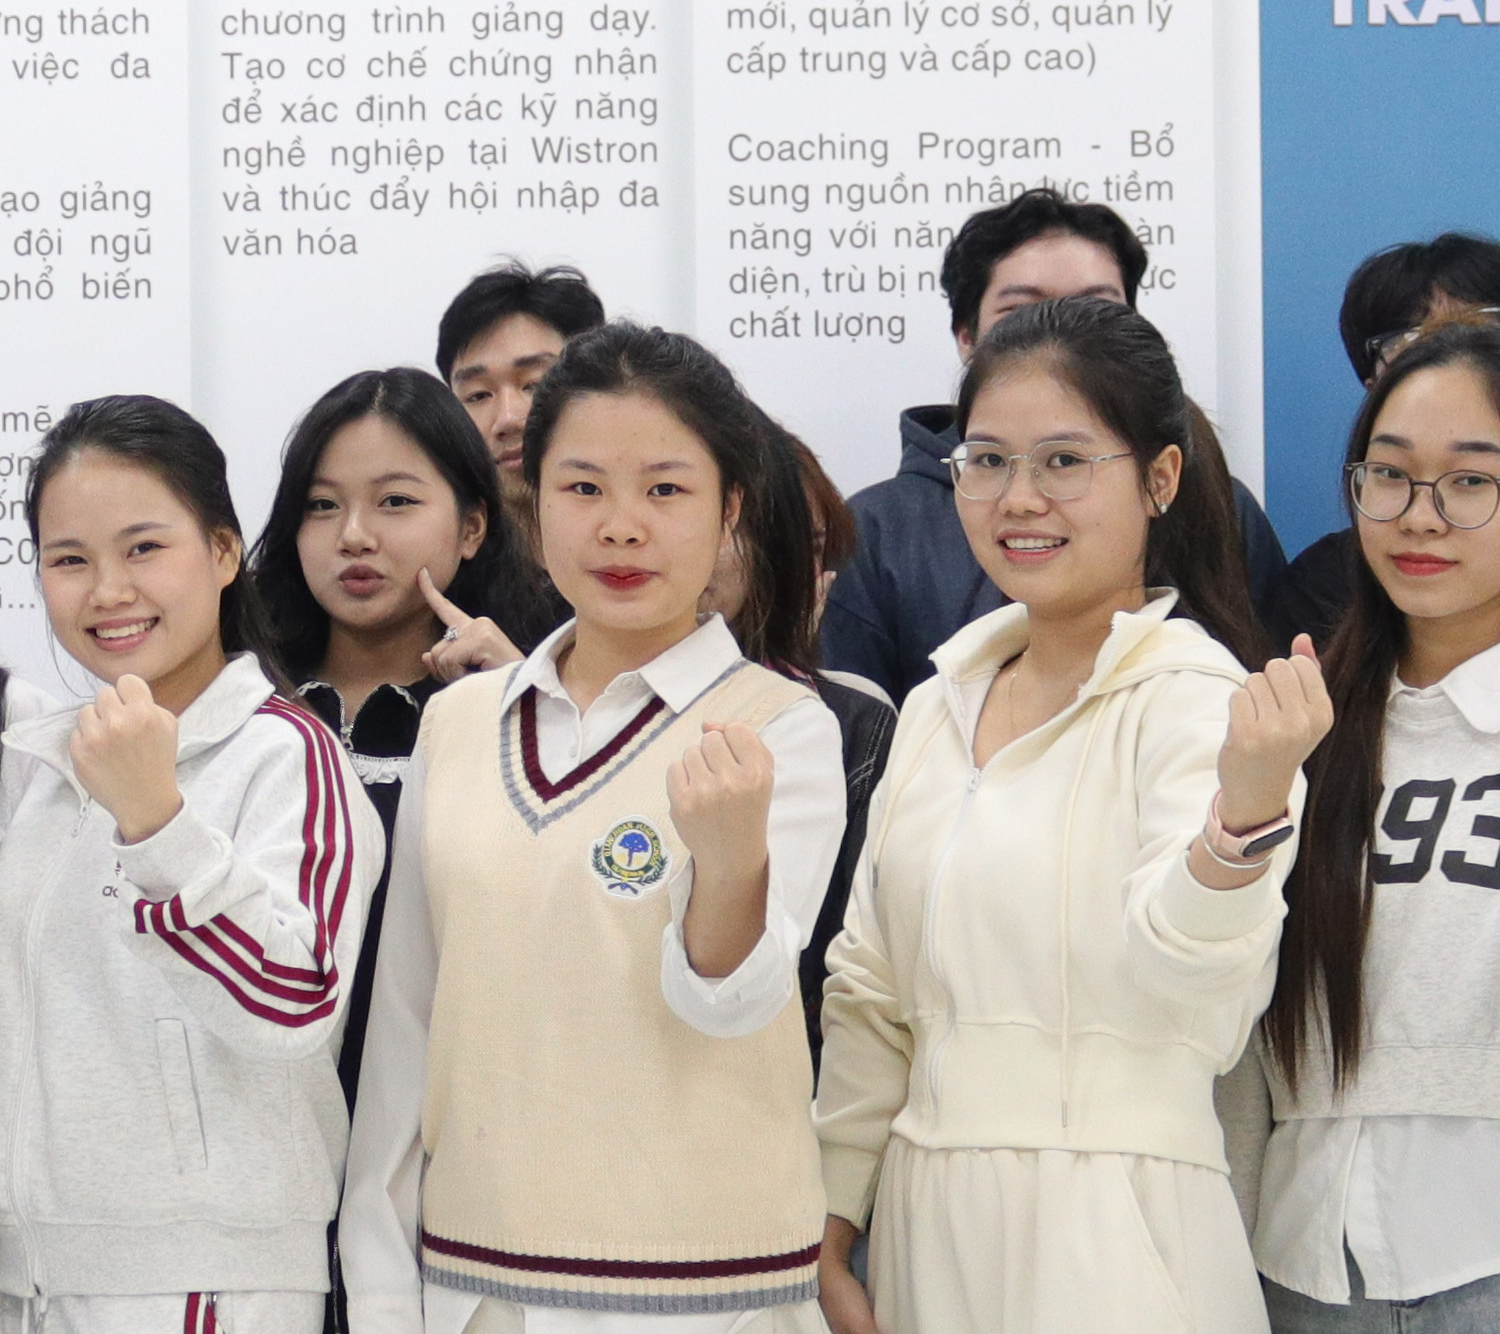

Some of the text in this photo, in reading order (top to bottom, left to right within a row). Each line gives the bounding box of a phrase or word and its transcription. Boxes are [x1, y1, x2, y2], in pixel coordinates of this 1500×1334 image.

[57, 6, 150, 36] thách
[220, 1, 656, 43] chương trình giảng dạy.
[726, 38, 1097, 81] cấp trung và cấp cao)
[222, 135, 658, 176] nghề nghiệp tại Wistron
[727, 122, 1175, 169] Coaching Program Bổ
[59, 180, 152, 220] giảng
[222, 226, 359, 257] văn hóa
[728, 265, 810, 300] diện,
[821, 264, 866, 294] trù
[877, 264, 906, 299] bị
[728, 305, 906, 345] chất lượng
